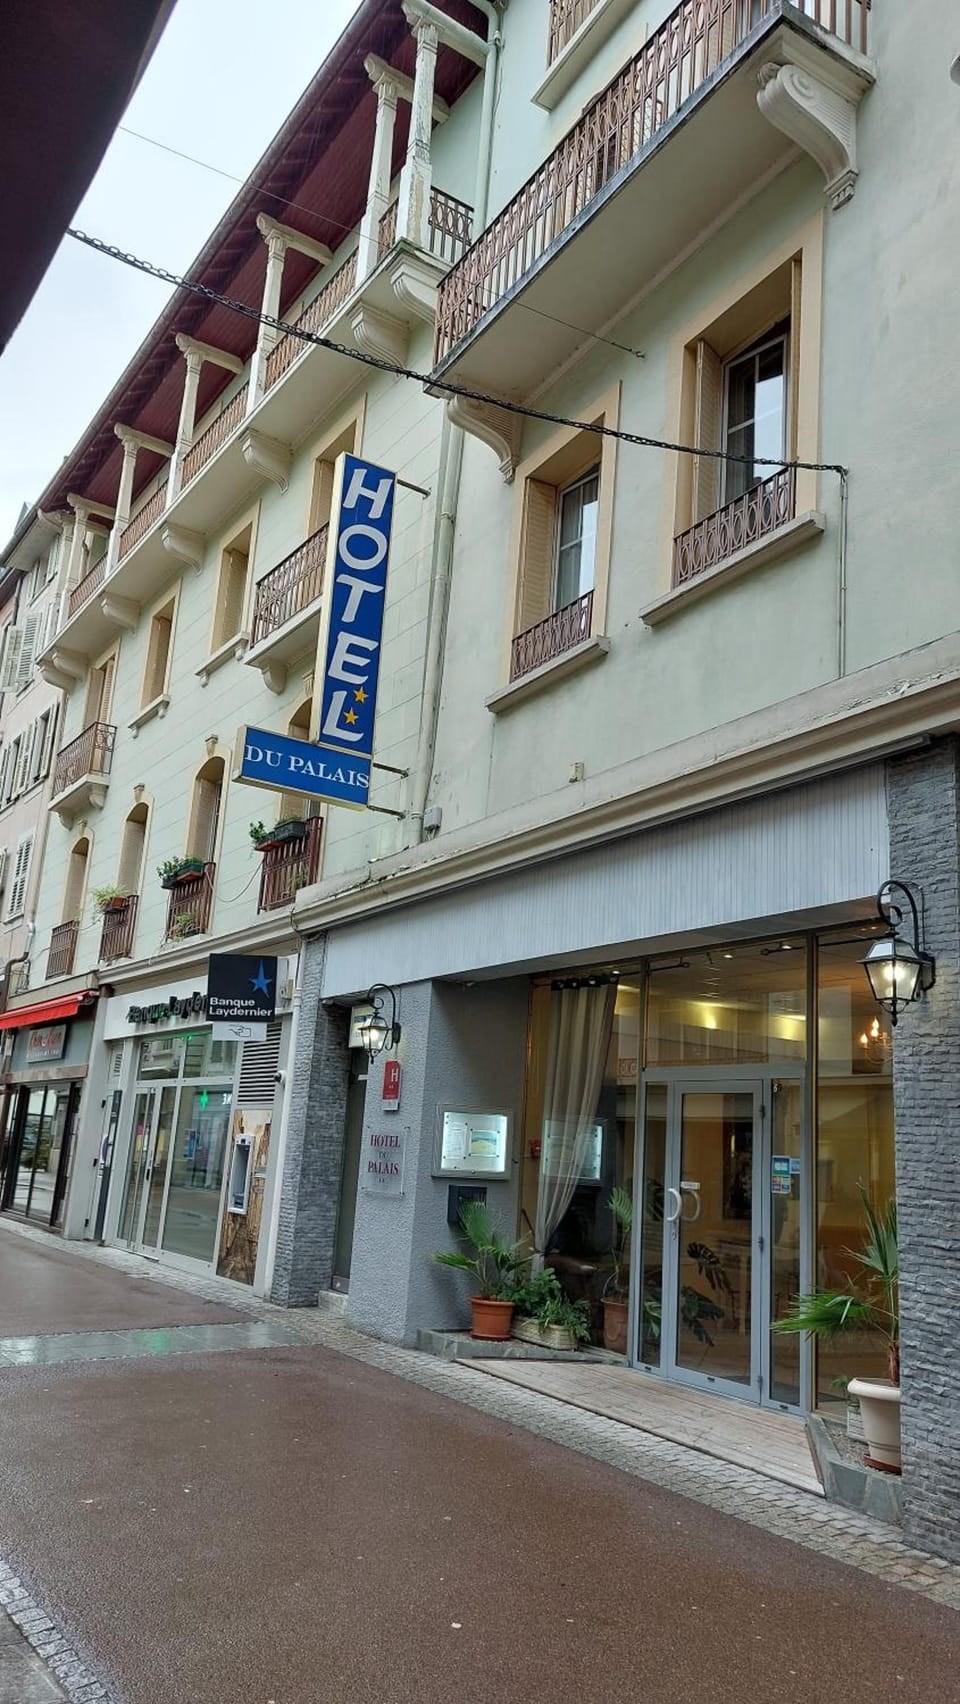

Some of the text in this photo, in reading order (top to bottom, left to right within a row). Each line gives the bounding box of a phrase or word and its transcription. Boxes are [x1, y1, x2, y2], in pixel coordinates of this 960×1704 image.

[321, 468, 393, 742] HOTEL
[244, 744, 370, 789] DU PALAIS
[209, 997, 255, 1008] Banque
[209, 1006, 272, 1017] Laydernier
[391, 1068, 399, 1082] H
[370, 1134, 401, 1148] HOTEL
[368, 1160, 399, 1175] PALAIS
